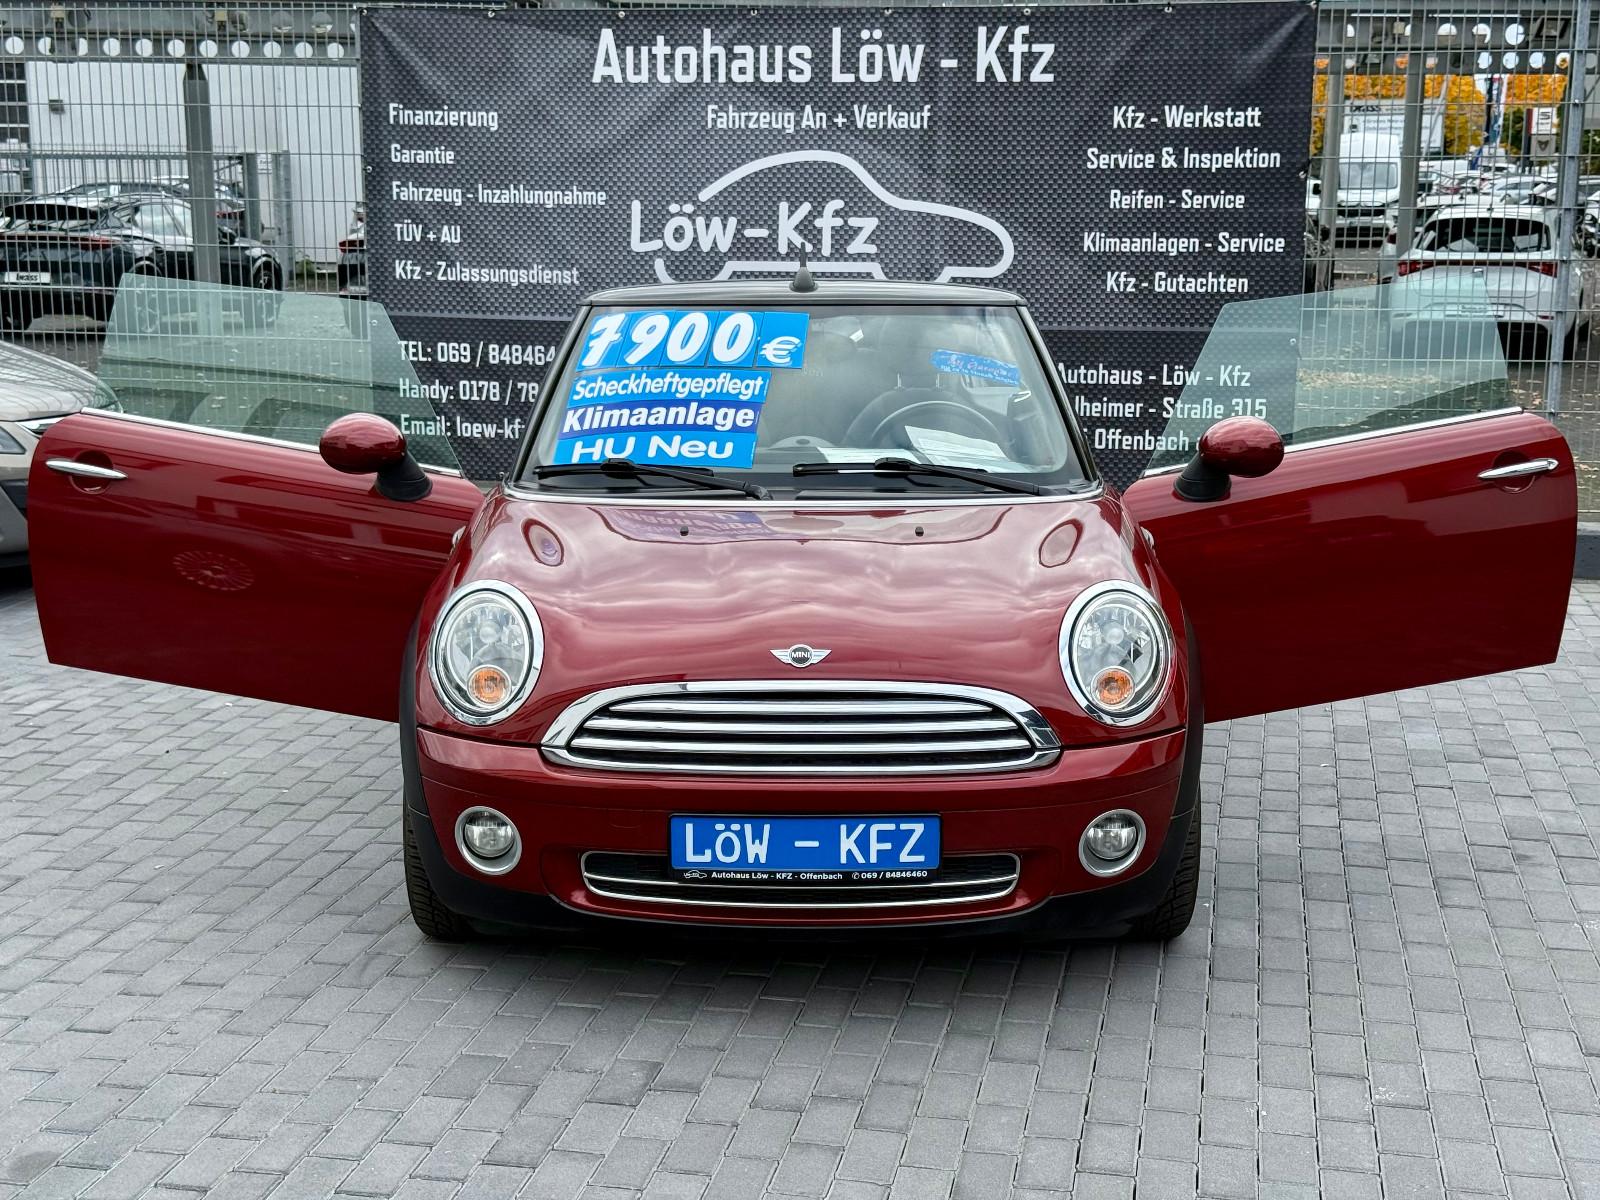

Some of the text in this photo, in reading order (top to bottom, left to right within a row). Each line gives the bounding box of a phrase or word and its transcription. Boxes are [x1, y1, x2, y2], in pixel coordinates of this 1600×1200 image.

[592, 28, 812, 83] Autohaus
[831, 27, 925, 83] Löw
[976, 26, 1055, 83] Kfz
[389, 103, 499, 131] Finanzierung
[706, 104, 796, 134] Fahrzeug
[800, 105, 827, 130] An
[853, 104, 931, 129] Verkauf
[1113, 106, 1145, 128] Kfz
[1164, 105, 1262, 128] Werkstatt
[390, 144, 455, 164] Garantie
[1086, 147, 1281, 172] Service & Inspektion
[392, 181, 462, 206] Fahrzeug
[478, 184, 607, 208] Inzahlungnahme
[1109, 189, 1164, 209] Reifen
[1181, 189, 1245, 209] Service
[394, 220, 423, 242] TÜV
[440, 224, 461, 243] AU
[630, 200, 880, 257] Löw-Kfz
[1083, 232, 1200, 256] Klimaanlagen
[1217, 232, 1285, 252] Service
[395, 260, 422, 280] Kfz
[436, 262, 580, 286] Zulassungsdienst
[1106, 272, 1136, 292] Kfz
[1154, 271, 1249, 292] Gutachten
[398, 341, 432, 362] TEL:
[437, 343, 471, 363] 069
[760, 336, 801, 364] €
[573, 372, 763, 399] Scheckheftgepflegt
[1162, 364, 1201, 386] Löw
[1219, 365, 1251, 387] Kfz
[399, 378, 454, 403] Handy:
[459, 380, 500, 402] 0178
[563, 402, 755, 431] Klimaanlage
[1162, 398, 1224, 419] Straße
[1231, 398, 1267, 419] 315
[401, 414, 526, 439] Email: loew-kf
[571, 435, 733, 463] HU Neu
[1094, 428, 1190, 451] Offenbach
[791, 651, 811, 659] MINI
[839, 823, 925, 864] KFZ
[711, 871, 750, 879] Autohaus
[752, 871, 769, 880] Löw
[776, 872, 793, 880] KFZ
[799, 872, 843, 880] Offenbach
[885, 870, 928, 879] 84846460
